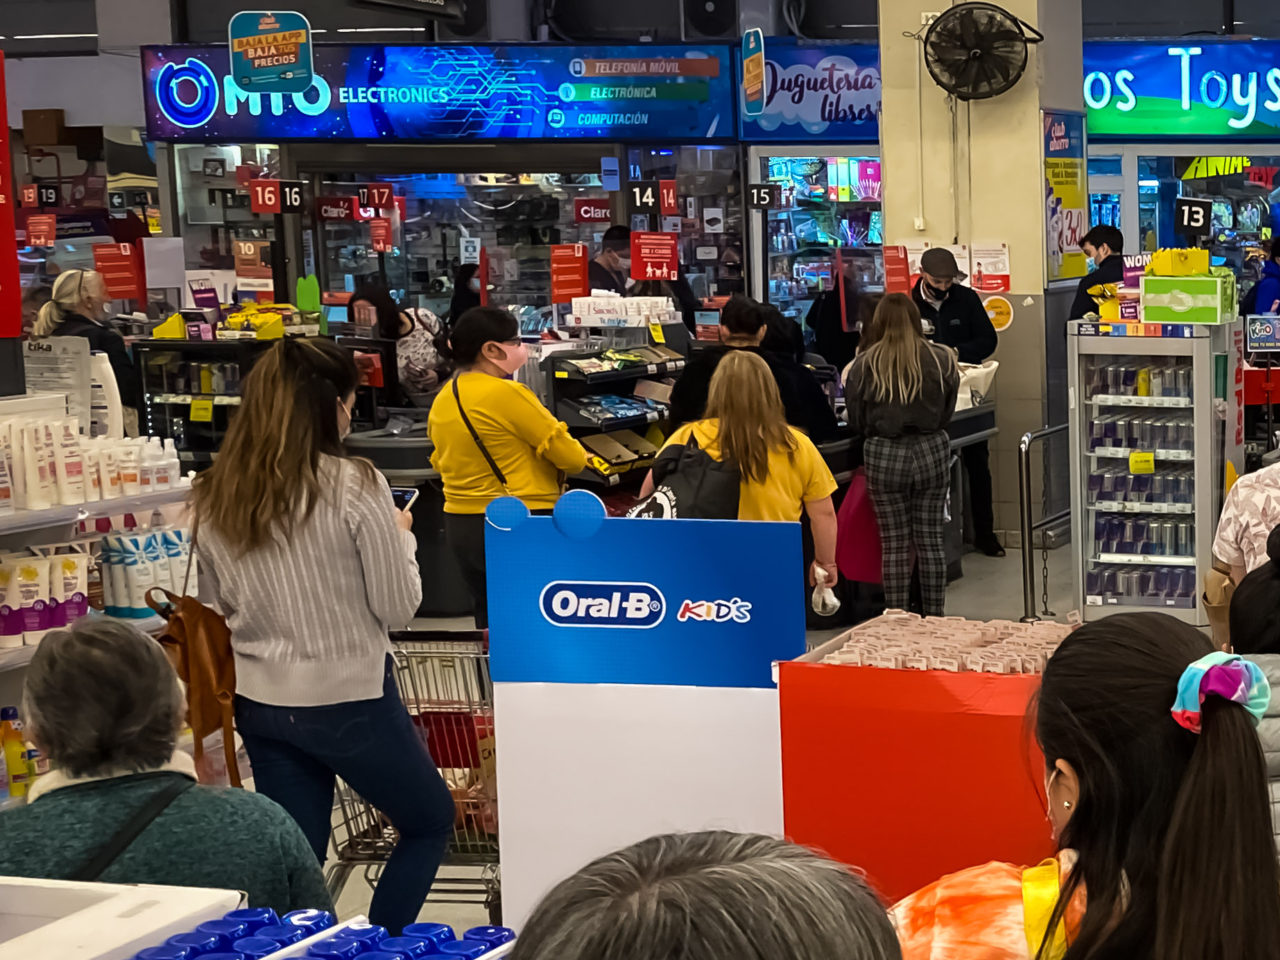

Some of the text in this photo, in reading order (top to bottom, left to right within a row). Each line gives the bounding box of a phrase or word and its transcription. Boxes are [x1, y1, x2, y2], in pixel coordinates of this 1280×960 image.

[237, 37, 263, 49] BAJA
[281, 31, 302, 42] APP
[247, 45, 277, 59] BAJA
[254, 54, 296, 68] PRECIOS
[594, 60, 681, 75] TELEFONÍA MÓVIL
[339, 86, 450, 104] ELECTRONICS
[590, 85, 657, 99] ELECTRÓNICA
[577, 112, 649, 126] COMPUTACIÓN
[41, 188, 57, 203] 19
[255, 186, 276, 206] 16
[284, 187, 301, 207] 16
[359, 188, 368, 205] 17
[371, 188, 390, 205] 17
[632, 186, 656, 207] 14
[662, 188, 676, 208] 14
[750, 188, 770, 206] 15
[321, 204, 348, 218] Claro
[1181, 204, 1205, 228] 13
[239, 242, 254, 256] 10
[28, 342, 52, 352] tika
[551, 590, 651, 619] Oral-B
